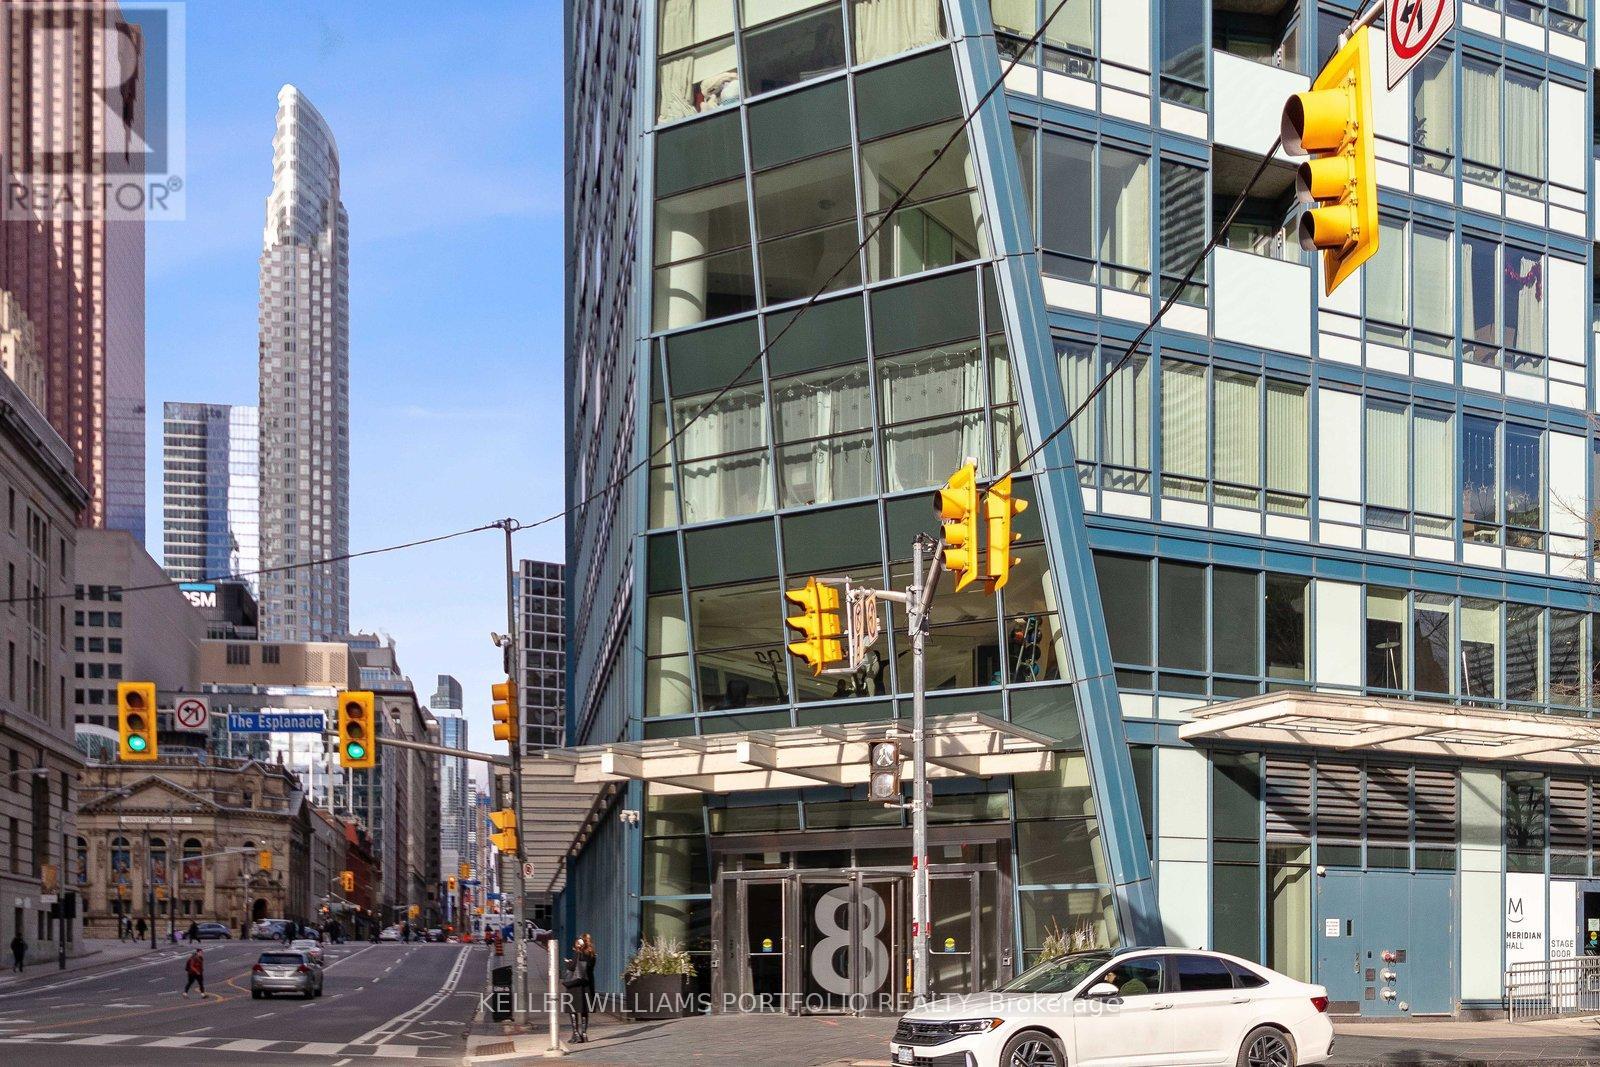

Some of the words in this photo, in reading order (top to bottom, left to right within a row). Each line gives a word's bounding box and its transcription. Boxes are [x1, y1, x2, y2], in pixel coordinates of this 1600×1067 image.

[230, 714, 253, 728] The
[258, 715, 322, 731] Esplanade
[1506, 931, 1542, 939] MERIDIAN
[811, 886, 889, 995] 8
[1551, 940, 1574, 948] STAGE
[1506, 941, 1524, 950] HALL
[1551, 950, 1571, 958] DOOR
